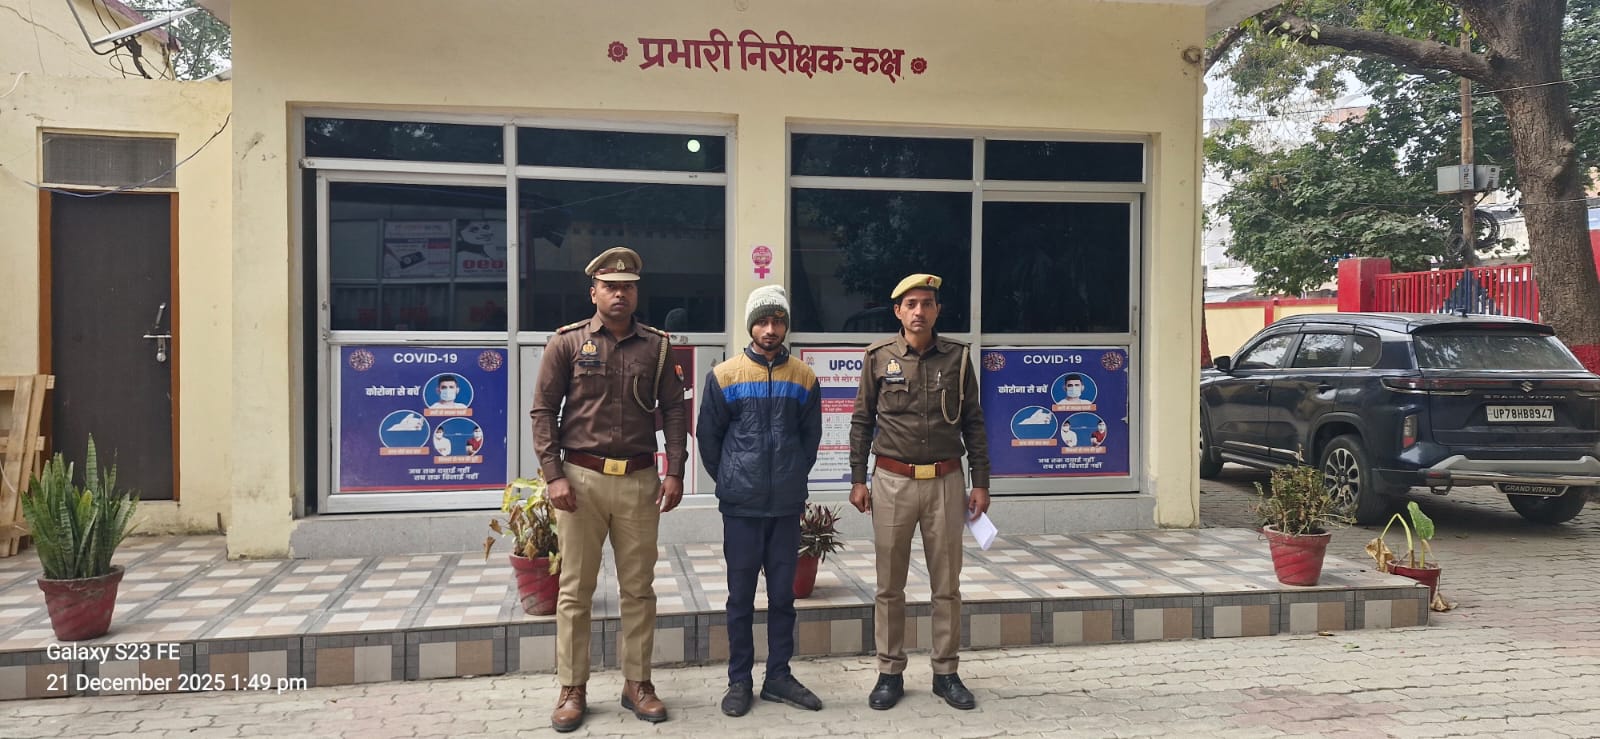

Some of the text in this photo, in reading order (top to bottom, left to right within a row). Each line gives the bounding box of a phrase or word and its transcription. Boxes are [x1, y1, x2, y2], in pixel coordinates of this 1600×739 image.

[638, 28, 904, 83] प्रभारी निरीक्षक-कक्ष
[393, 353, 458, 364] COVID-19
[1023, 354, 1083, 364] COVID-19
[829, 360, 862, 370] UPCO
[366, 385, 395, 396] कोरोना
[397, 385, 405, 396] से
[998, 384, 1025, 394] कोरोना
[1027, 384, 1035, 394] से
[1493, 408, 1553, 419] UP78HB8947
[1532, 486, 1556, 494] VITARA
